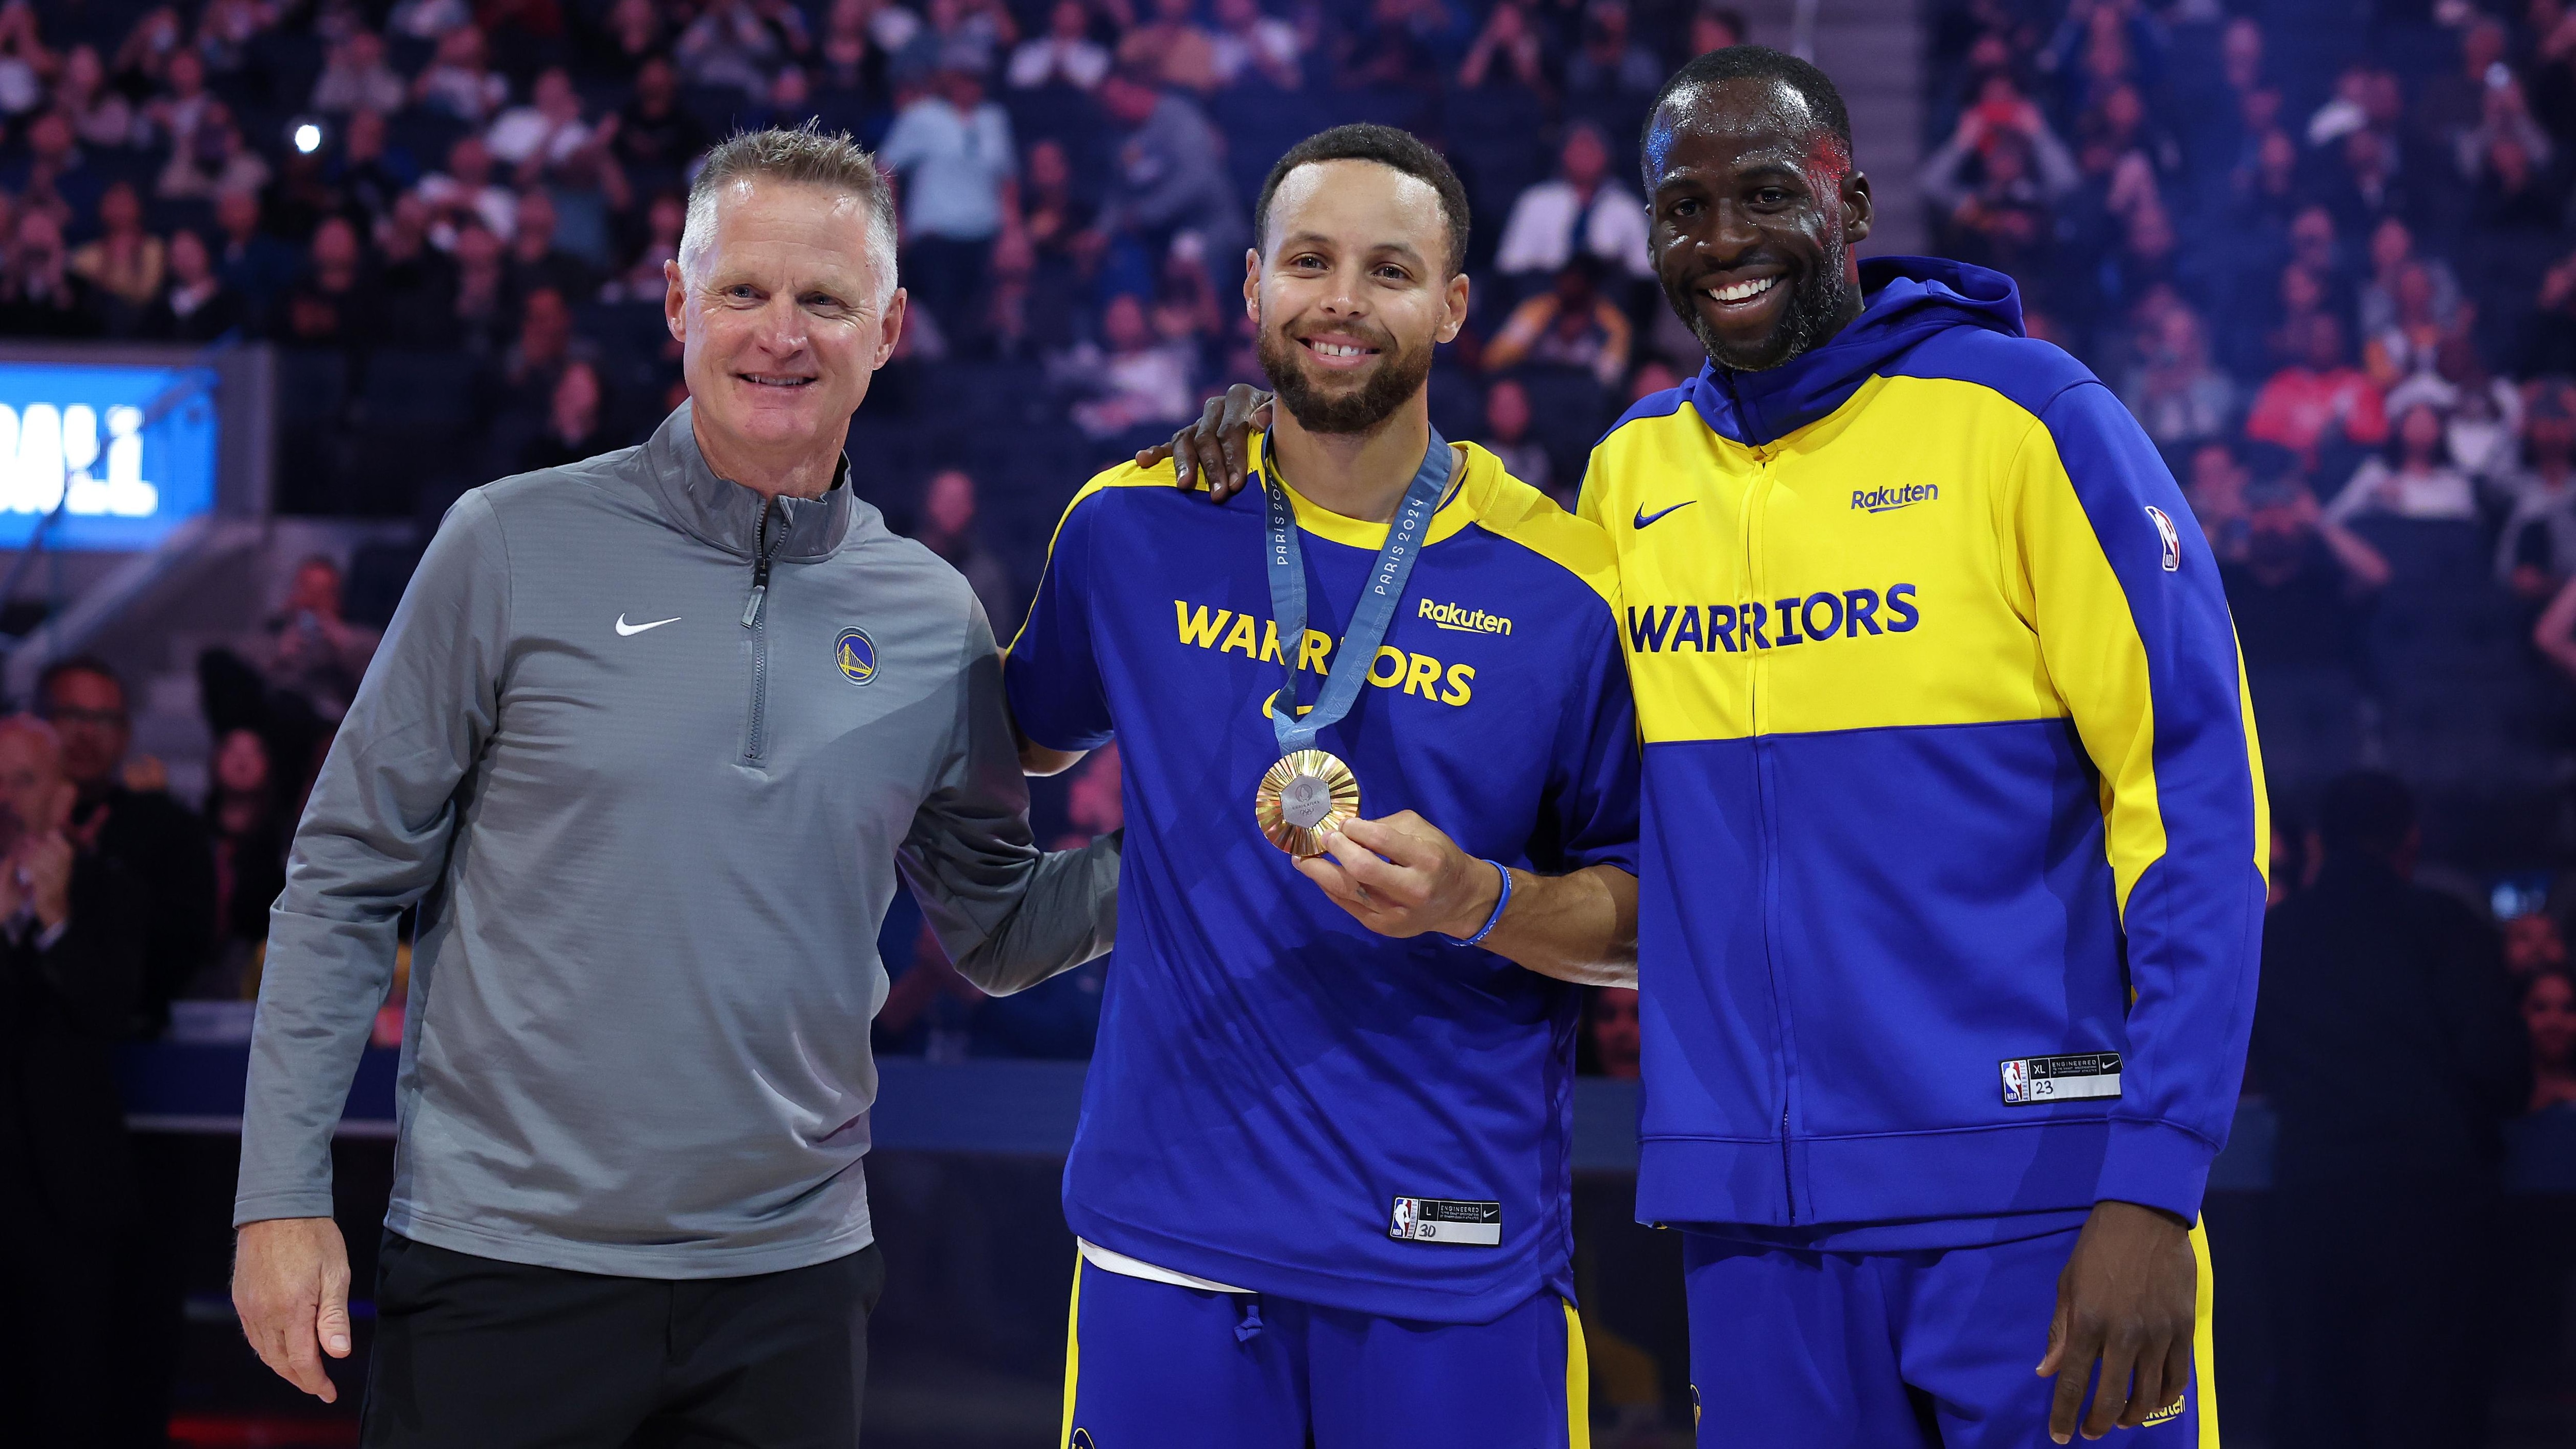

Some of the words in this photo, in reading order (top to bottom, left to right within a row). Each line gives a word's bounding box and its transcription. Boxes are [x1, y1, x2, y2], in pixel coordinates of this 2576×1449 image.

[1851, 483, 1938, 510] Rakuten
[1398, 499, 1424, 541] 2024
[1418, 598, 1512, 636] Rakuten
[1628, 583, 1920, 653] WARRIORS
[1174, 600, 1476, 706] WARRORS
[2033, 1065, 2046, 1075] XL
[2052, 1060, 2096, 1068] ENGINEERED
[2036, 1080, 2054, 1095] 23
[2007, 1092, 2017, 1100] NBA
[1426, 1206, 1432, 1216] L
[1418, 1223, 1436, 1238] 30
